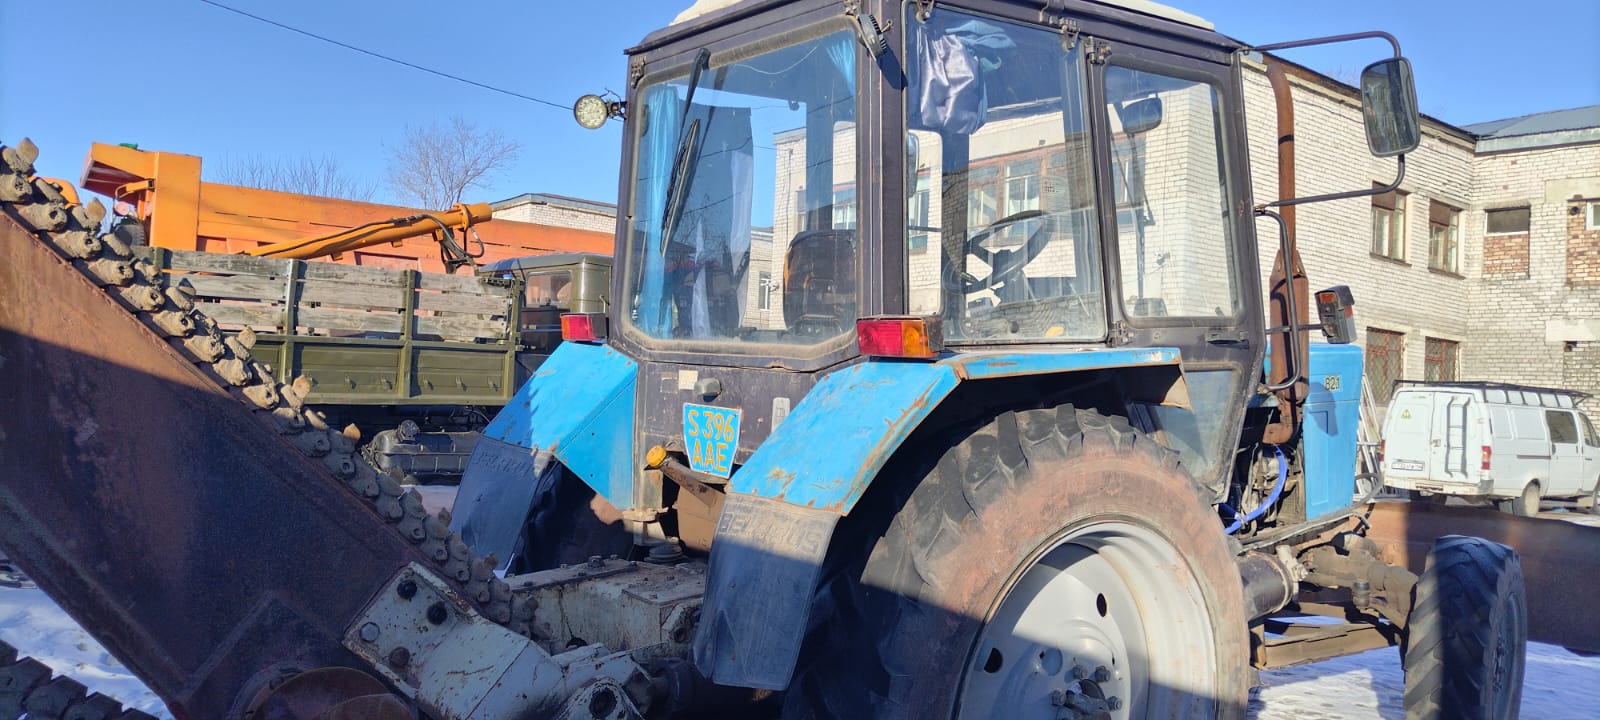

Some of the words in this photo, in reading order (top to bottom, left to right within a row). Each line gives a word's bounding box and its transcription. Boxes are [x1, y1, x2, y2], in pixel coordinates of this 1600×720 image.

[688, 410, 699, 437] S
[703, 411, 734, 442] 396
[692, 439, 728, 472] AAE
